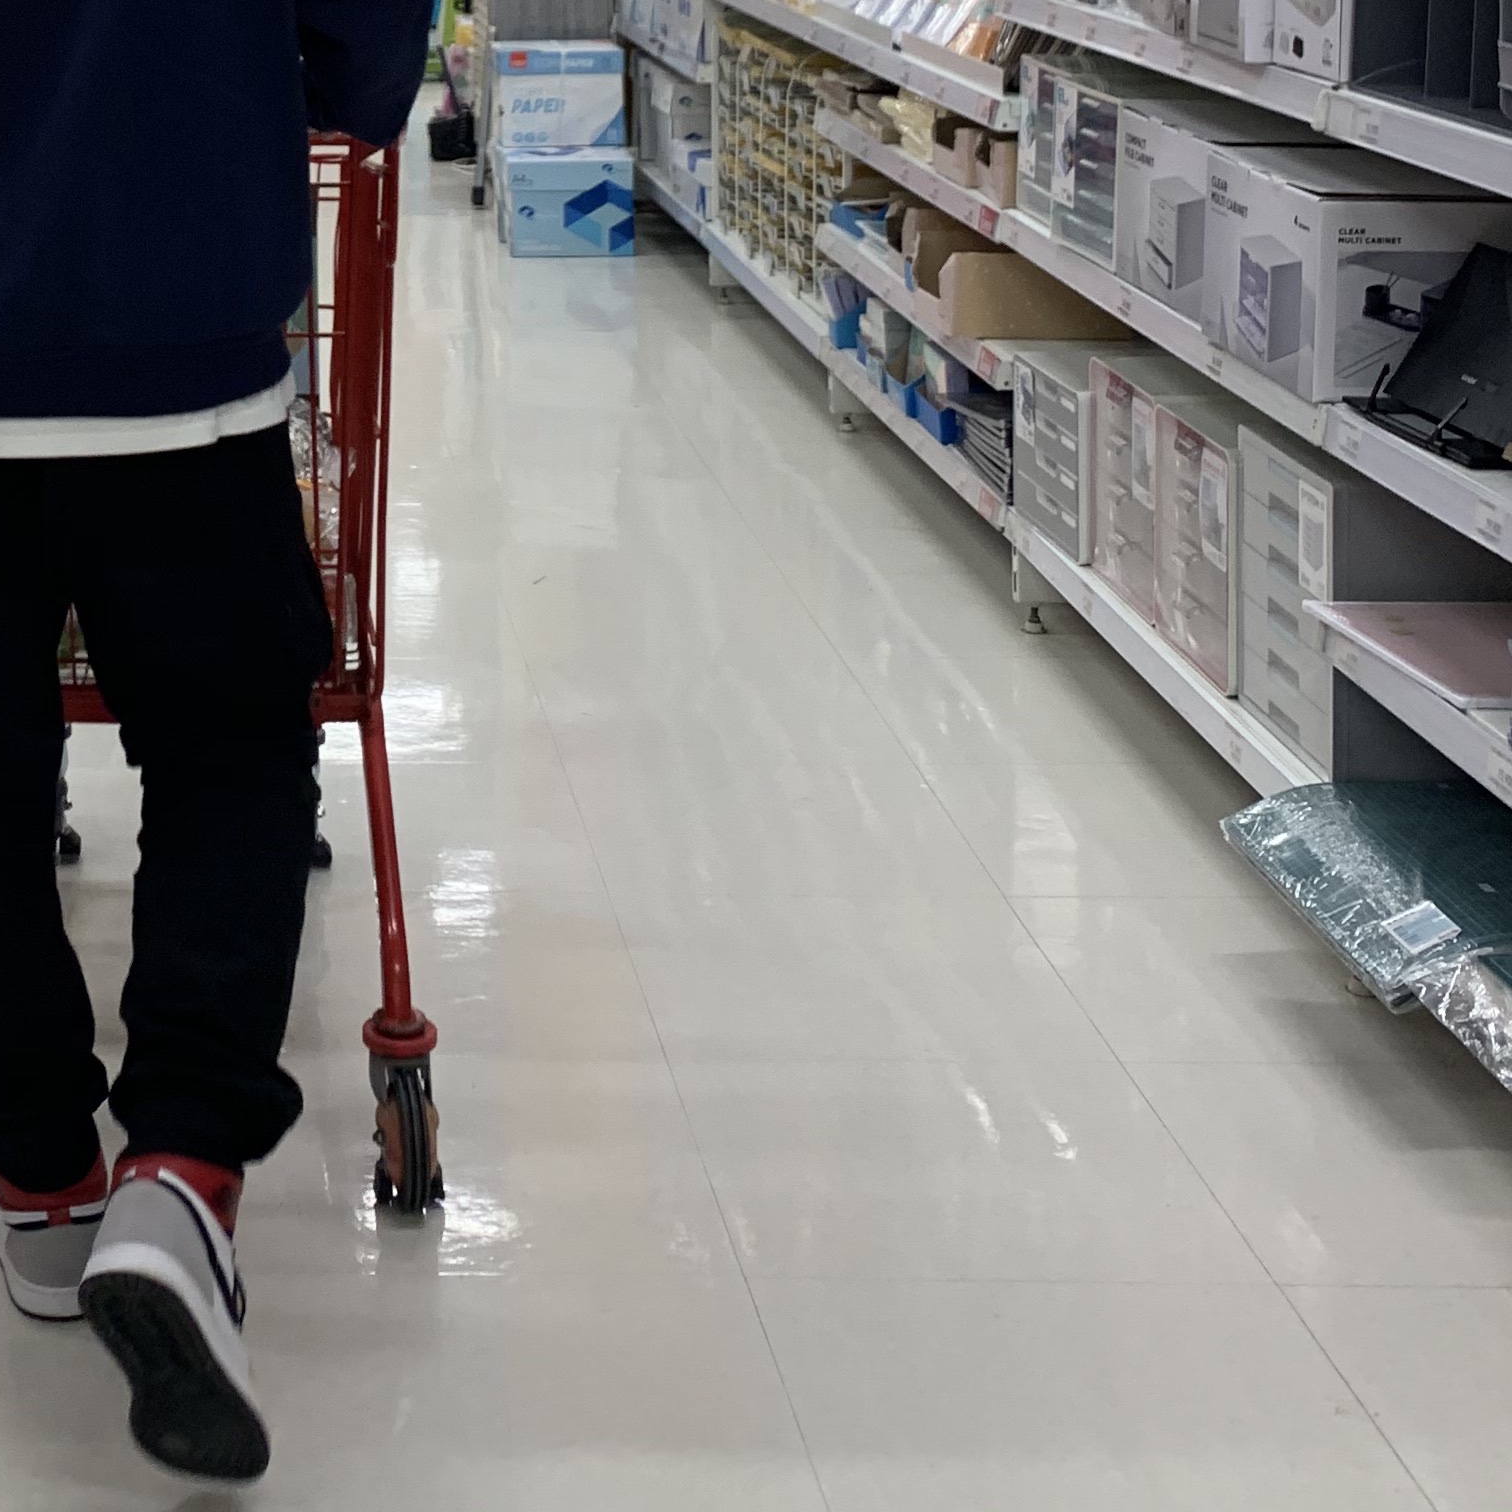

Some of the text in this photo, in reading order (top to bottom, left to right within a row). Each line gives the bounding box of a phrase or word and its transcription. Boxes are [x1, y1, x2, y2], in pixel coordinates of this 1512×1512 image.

[510, 96, 567, 115] PAPER
[1338, 227, 1366, 236] CLEAR
[1337, 236, 1403, 245] MULTI CABINET
